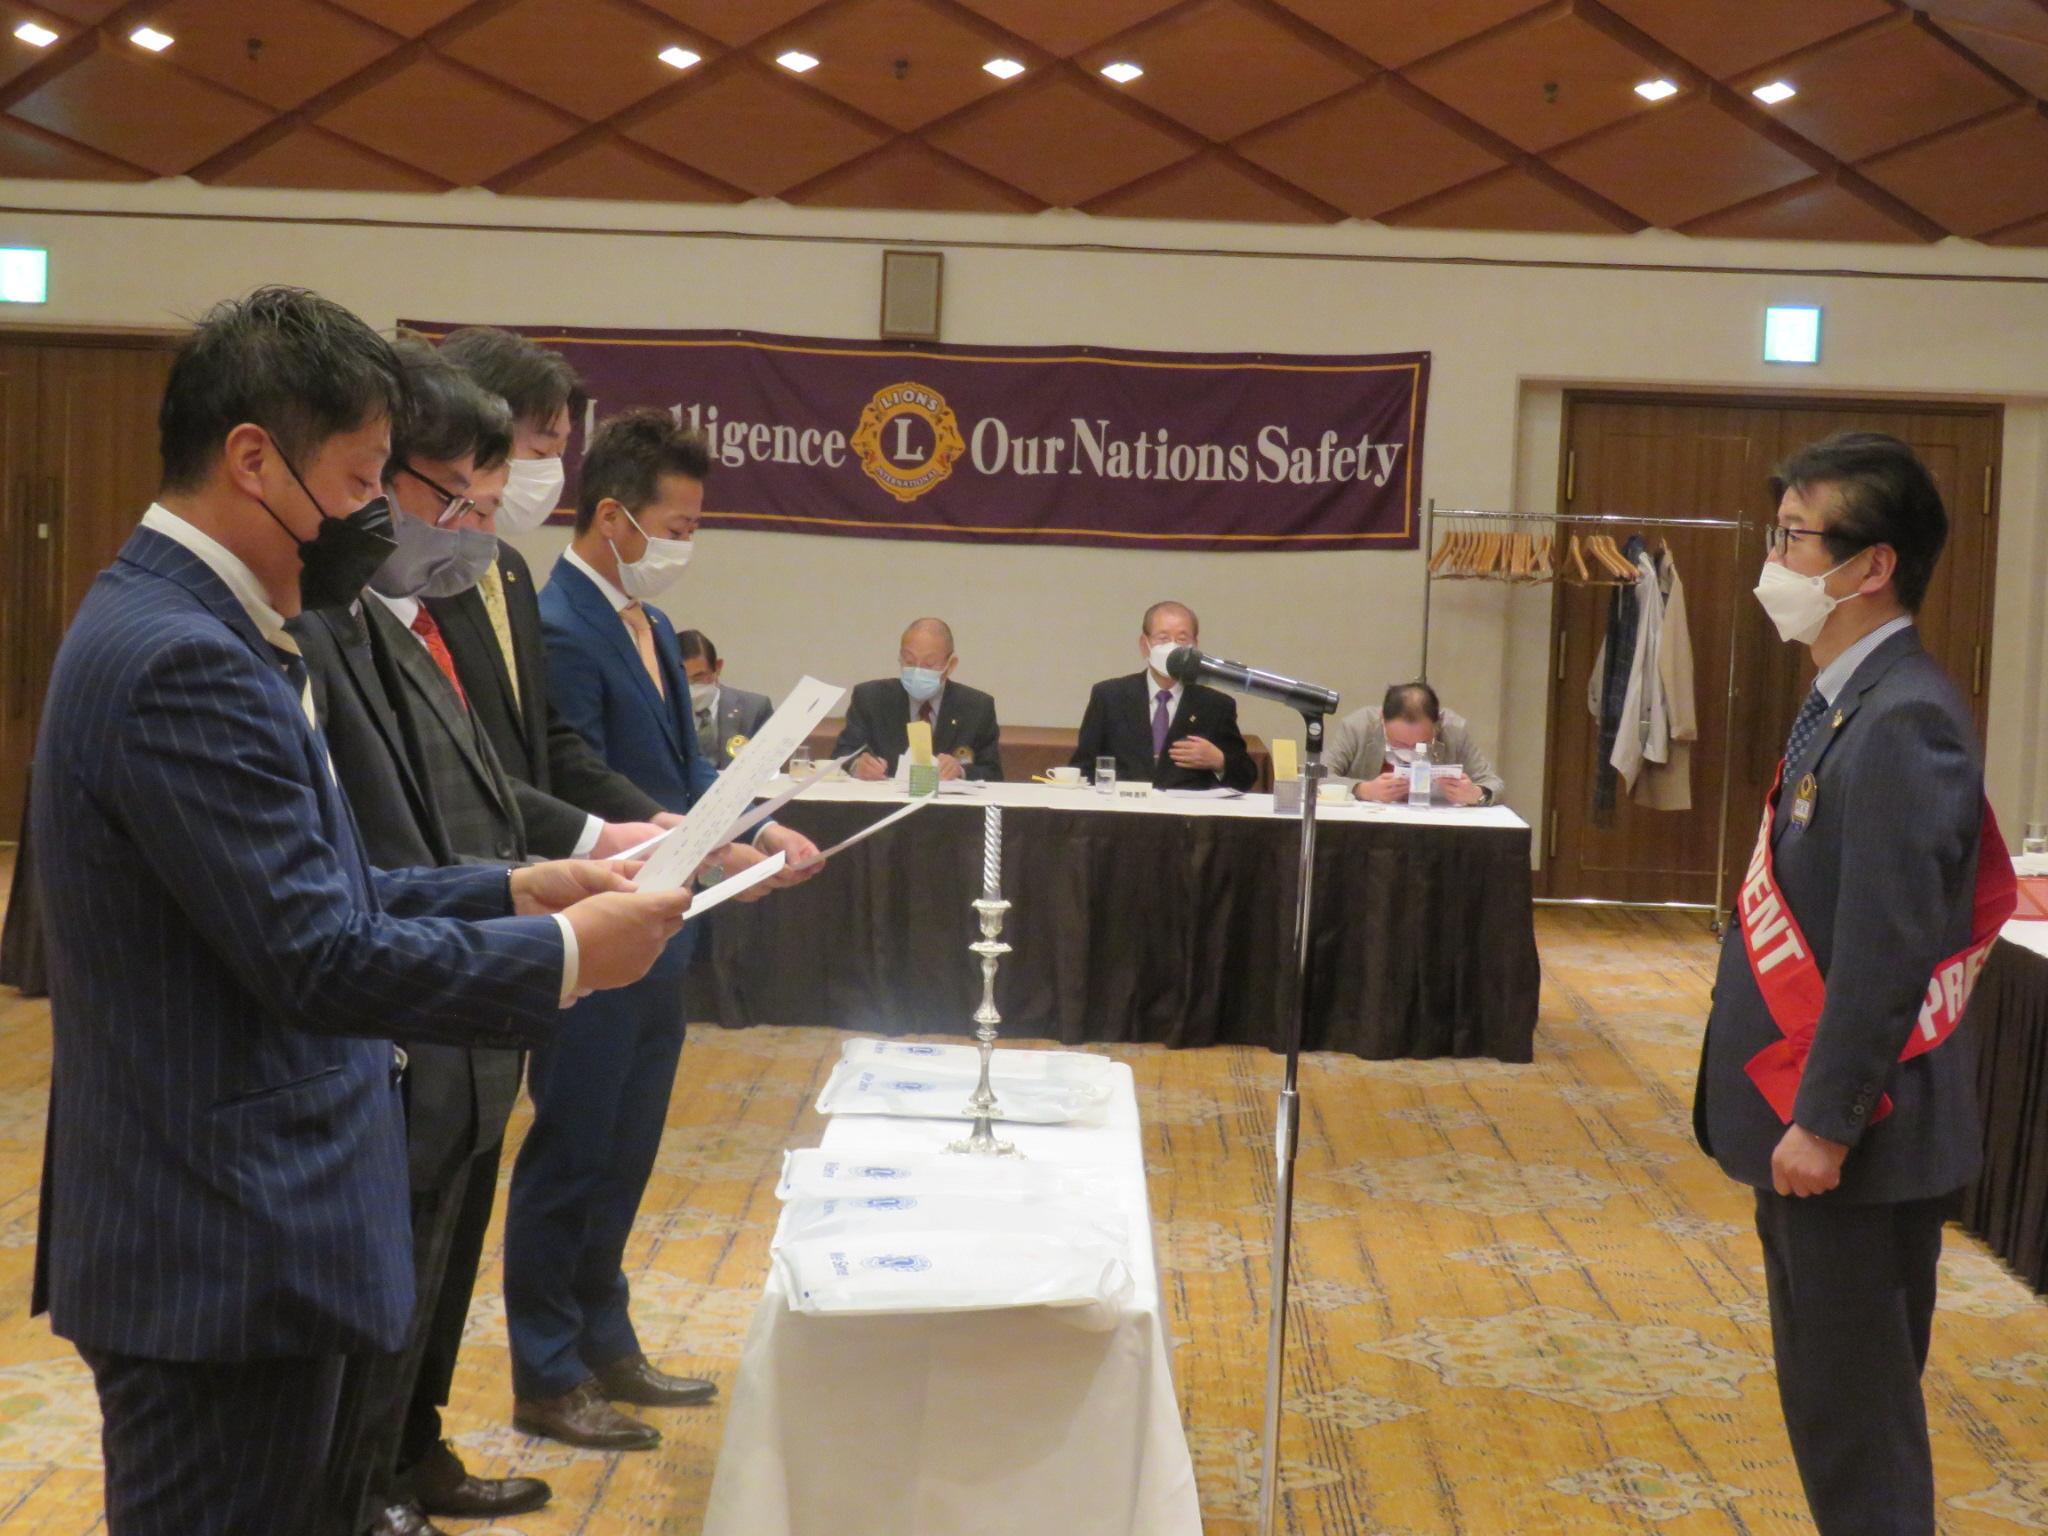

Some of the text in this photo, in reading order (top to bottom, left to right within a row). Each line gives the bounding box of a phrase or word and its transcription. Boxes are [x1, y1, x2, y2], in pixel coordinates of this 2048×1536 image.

[880, 390, 938, 411] LIONS
[893, 418, 925, 461] L
[970, 417, 1404, 487] Our Nations Safety
